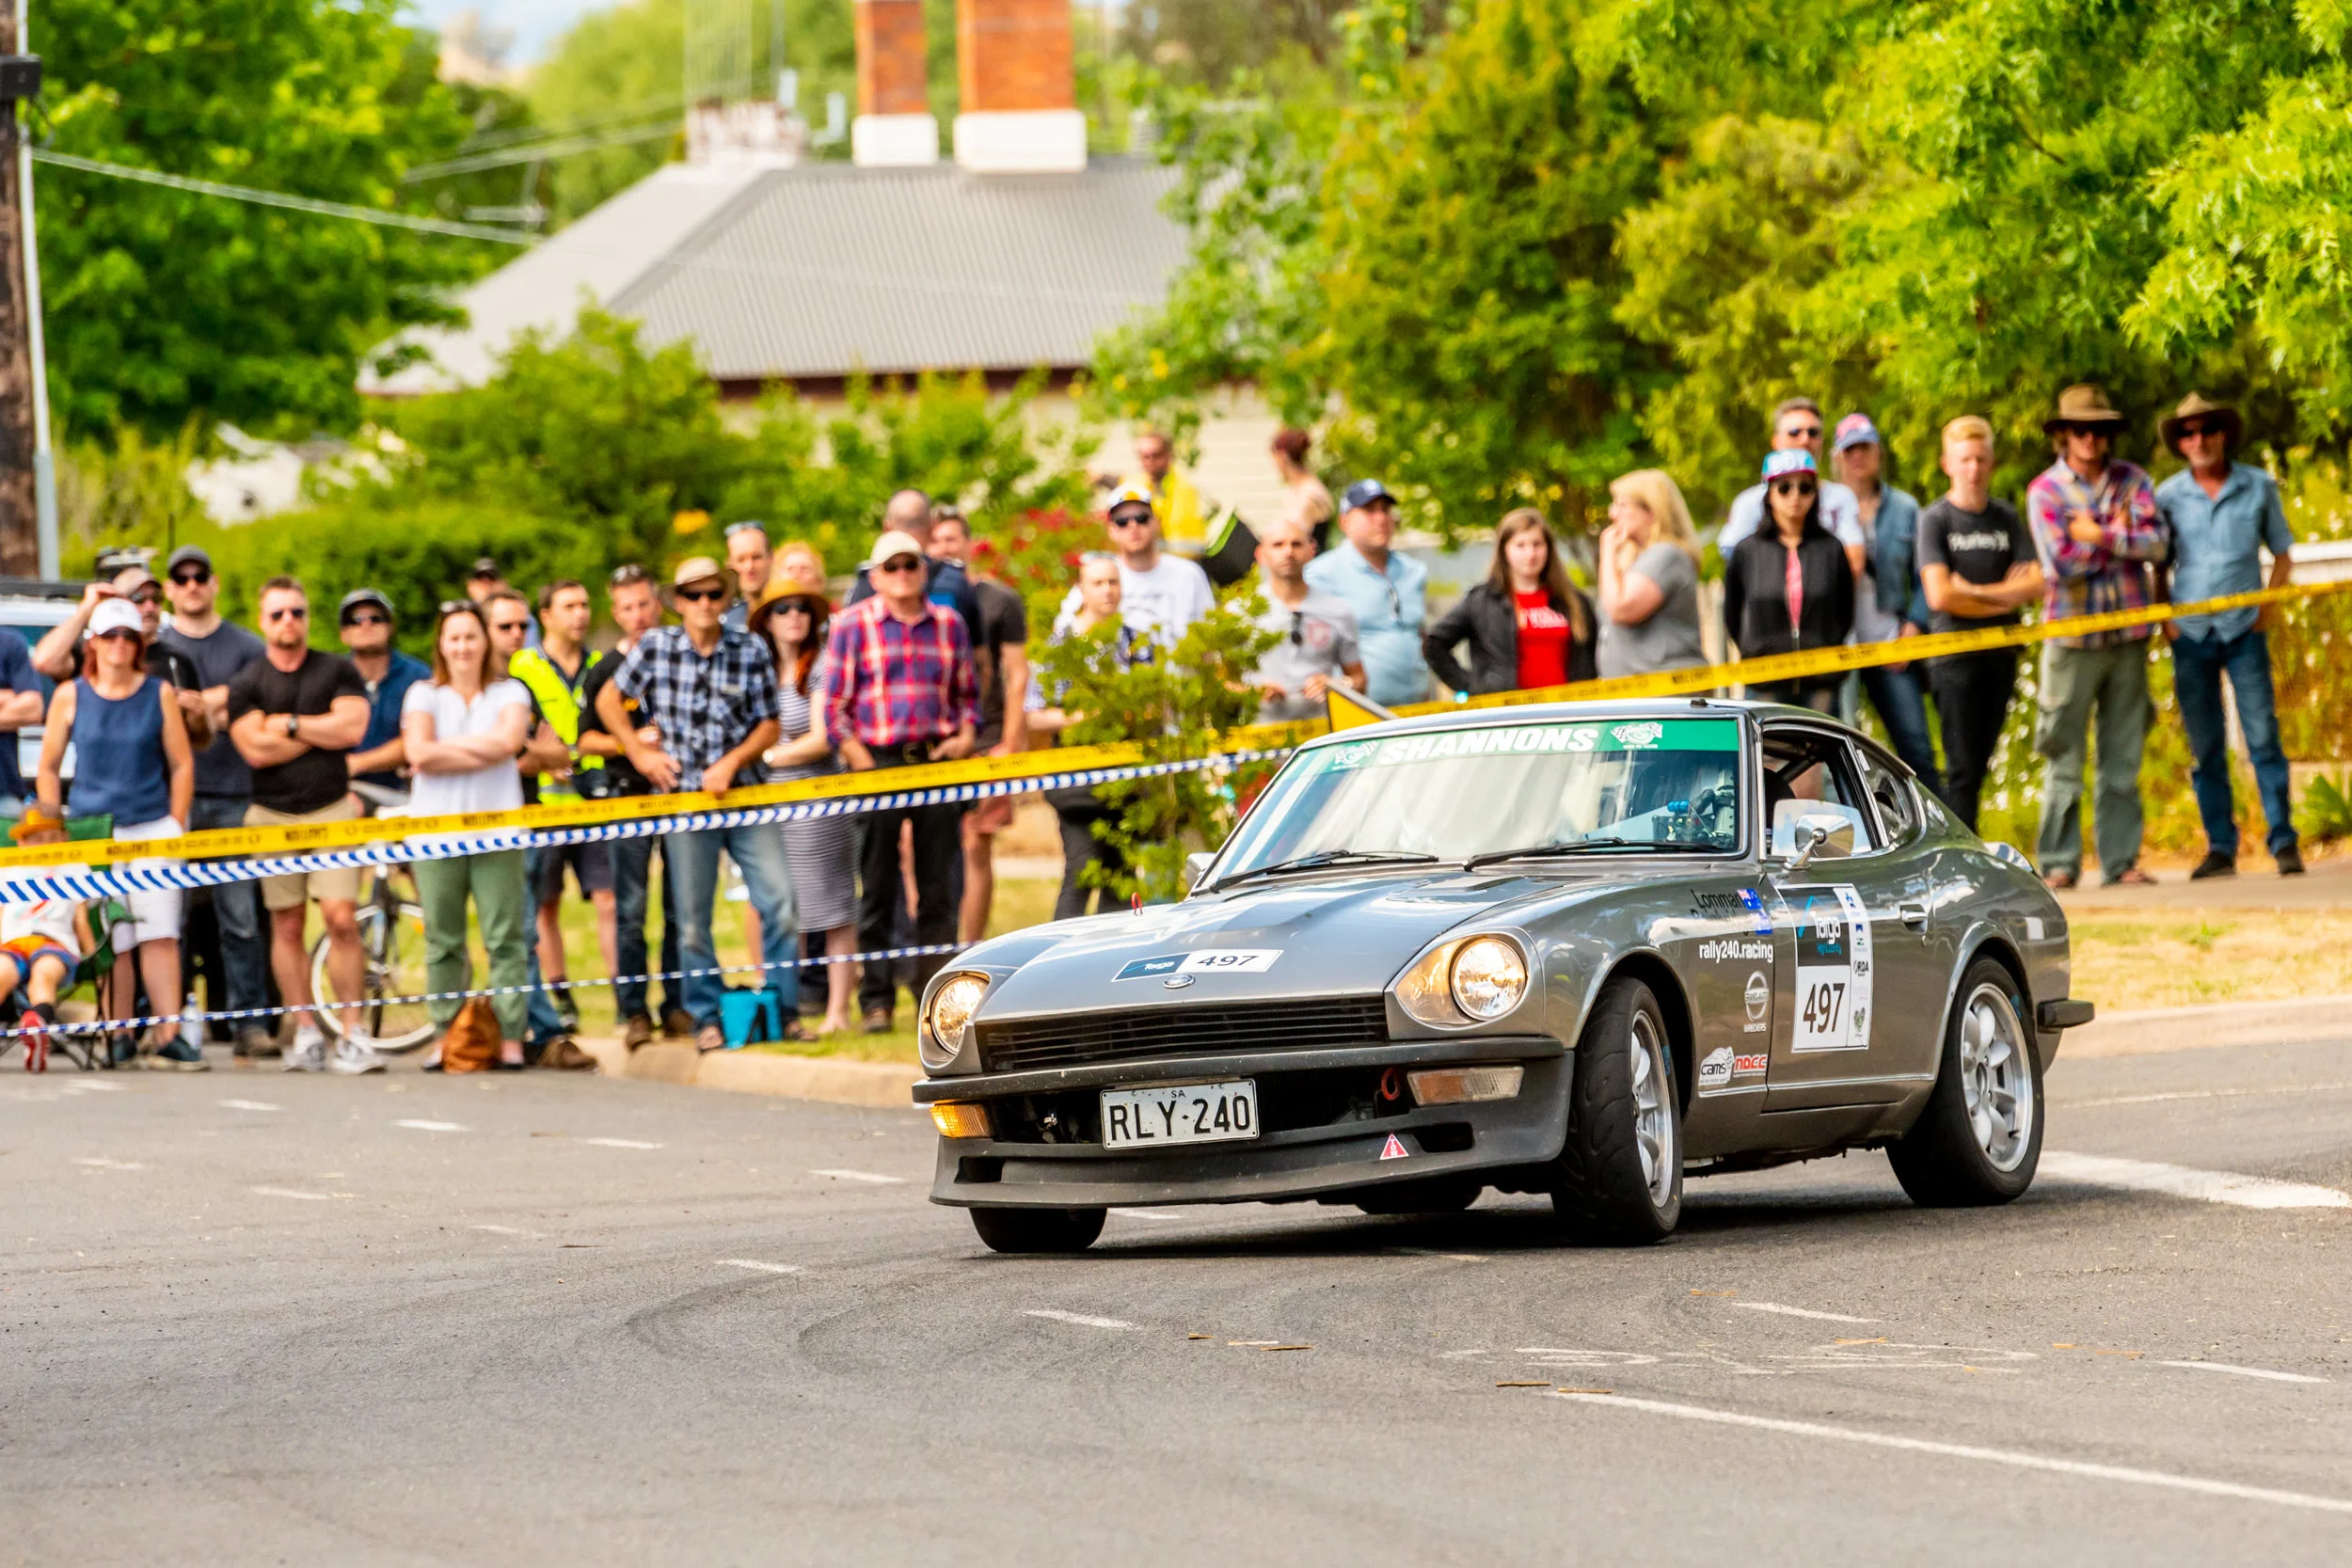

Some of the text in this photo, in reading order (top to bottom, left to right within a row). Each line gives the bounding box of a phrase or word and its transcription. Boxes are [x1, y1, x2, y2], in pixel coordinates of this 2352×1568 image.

[1380, 728, 1598, 764] SHANNONS
[1198, 955, 1259, 967] 497
[1699, 940, 1773, 963] rally240.racing
[1803, 983, 1845, 1034] 497
[1171, 1089, 1186, 1099] SA
